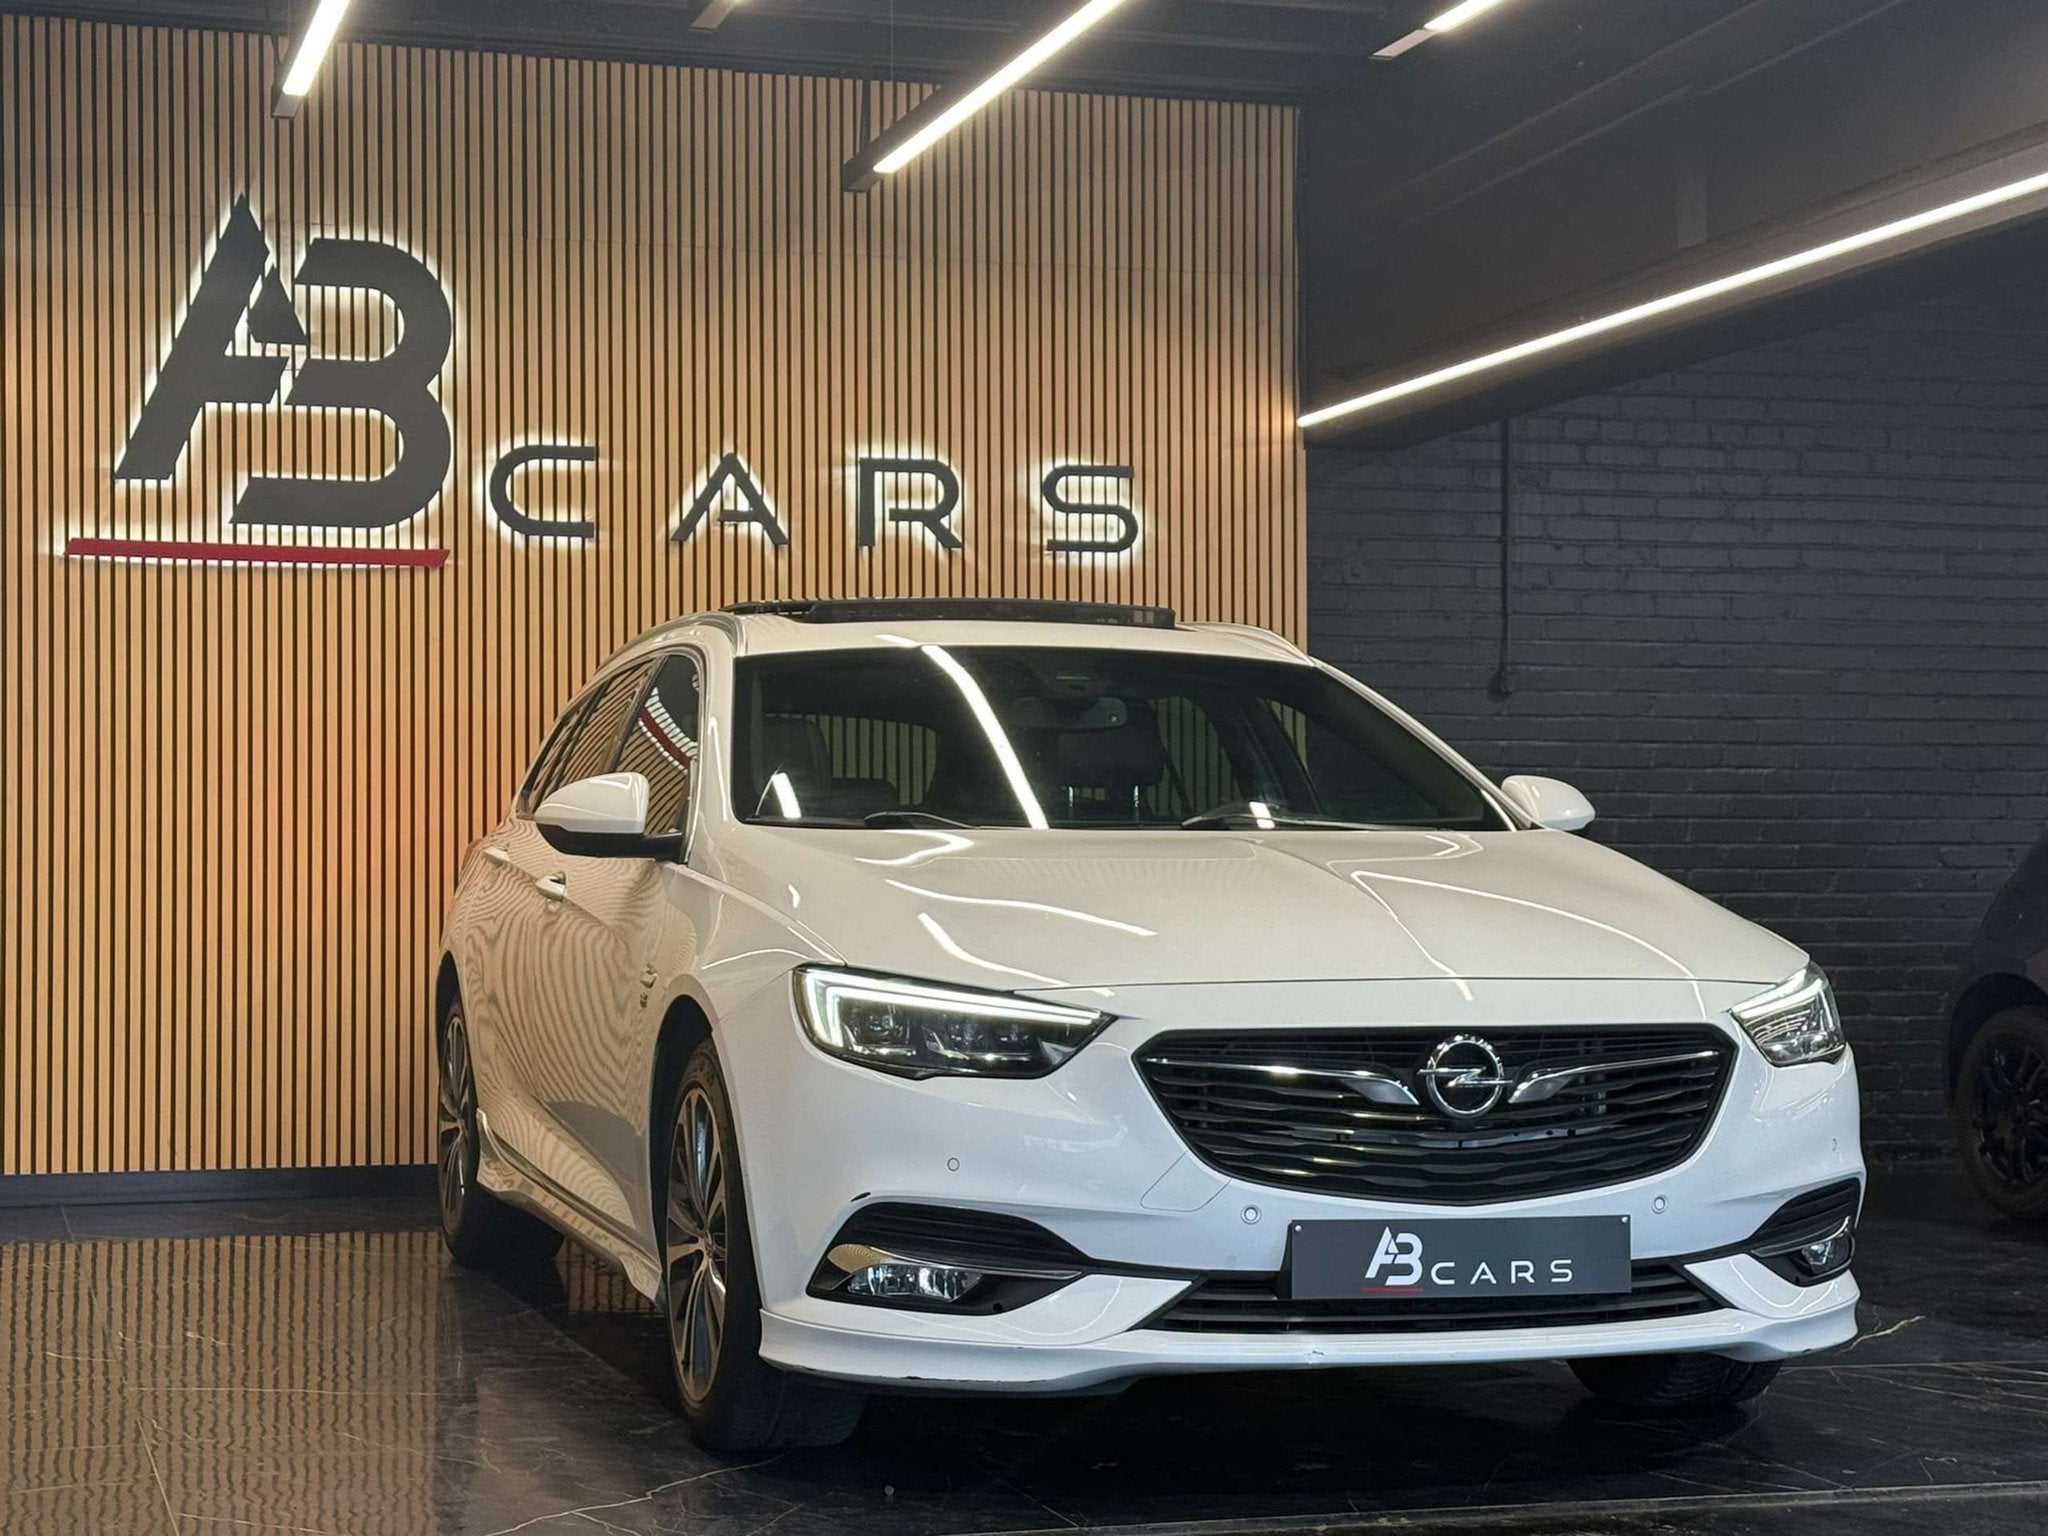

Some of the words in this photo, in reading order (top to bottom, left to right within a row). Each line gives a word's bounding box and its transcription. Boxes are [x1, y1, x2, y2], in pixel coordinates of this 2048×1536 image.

[113, 193, 452, 528] AB
[488, 444, 1139, 554] CARS
[1364, 1226, 1424, 1286] AB
[1430, 1259, 1575, 1285] CARS
